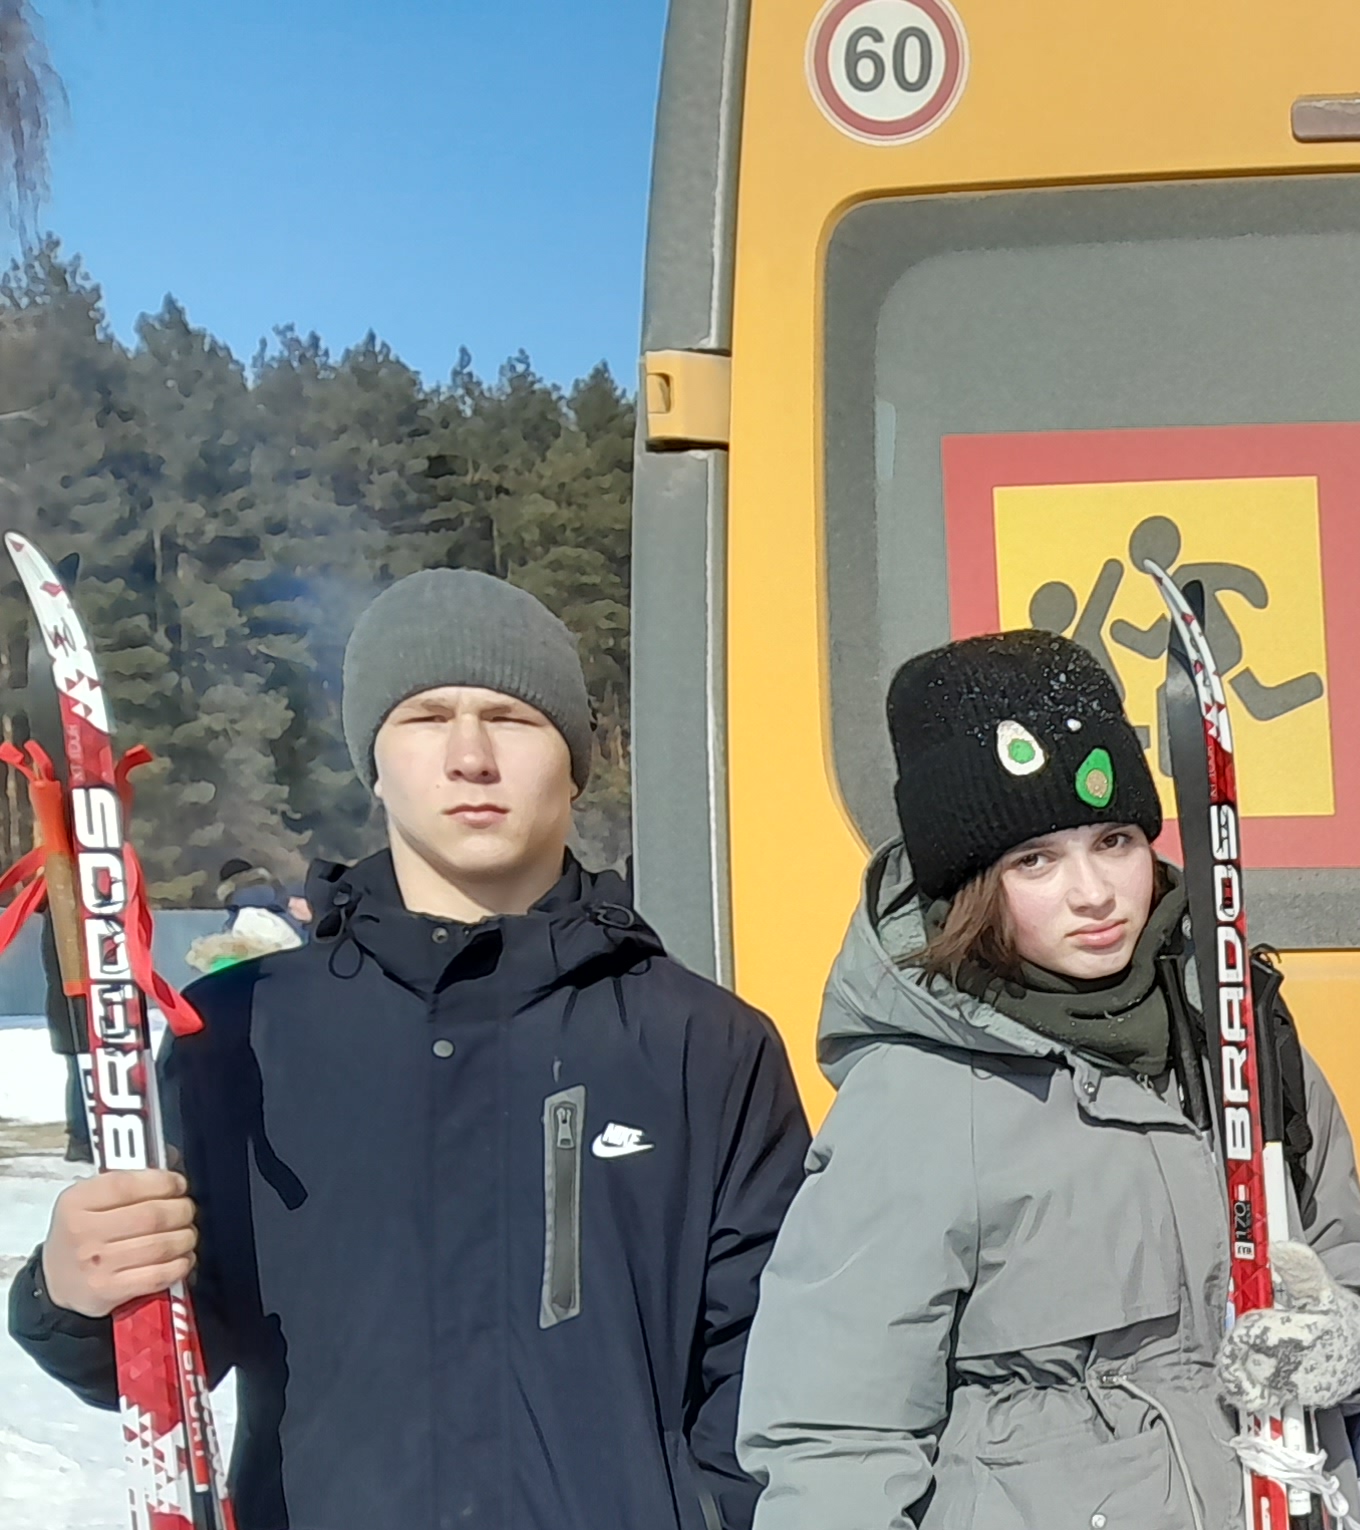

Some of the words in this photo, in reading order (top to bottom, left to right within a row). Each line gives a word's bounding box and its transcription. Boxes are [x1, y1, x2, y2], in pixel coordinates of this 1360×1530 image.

[844, 26, 932, 92] 60
[1210, 803, 1252, 1160] BRADOS
[603, 1122, 643, 1147] NIKE
